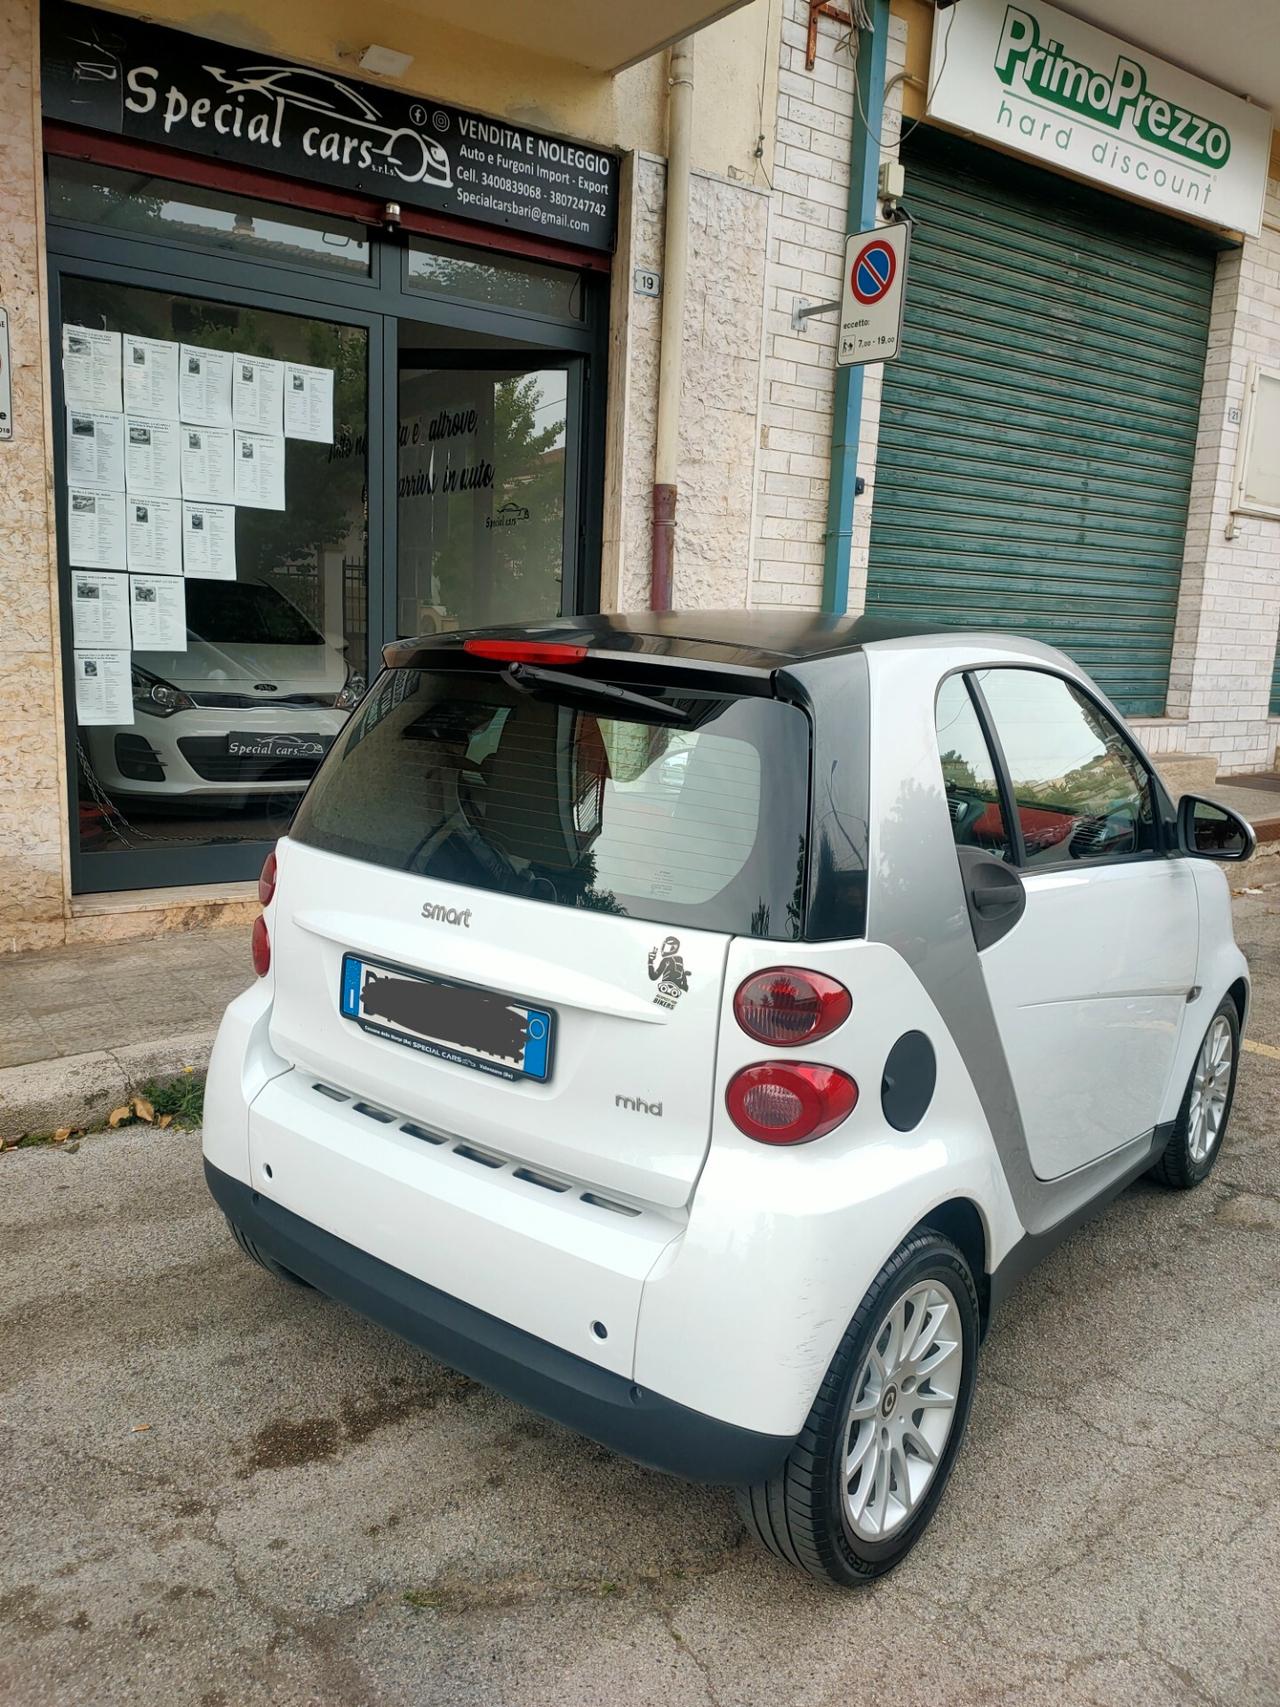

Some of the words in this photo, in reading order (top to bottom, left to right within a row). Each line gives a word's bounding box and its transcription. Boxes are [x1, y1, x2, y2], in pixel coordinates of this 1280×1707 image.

[994, 4, 1231, 169] PrimoPrezzo
[125, 66, 283, 148] Special
[302, 126, 374, 169] cars
[458, 116, 522, 152] VENDITA
[526, 136, 534, 155] E
[538, 139, 610, 176] NOLEGGIO
[459, 144, 485, 162] Auto
[487, 154, 494, 165] e
[497, 153, 534, 174] Furgoni
[536, 166, 570, 185] Import
[578, 176, 609, 195] Export
[996, 100, 1073, 150] hard
[1091, 141, 1212, 204] discount
[456, 166, 479, 183] Cell.
[481, 172, 542, 200] 3400839068
[550, 191, 607, 217] 3807247742
[457, 187, 590, 232] Specialcarsbari@gmail.com
[642, 275, 654, 290] 19
[228, 742, 273, 756] Special
[276, 746, 298, 756] cars
[421, 902, 472, 928] smart
[412, 1041, 440, 1056] SPECIAL
[441, 1051, 462, 1063] CARS
[615, 1095, 662, 1117] mhd
